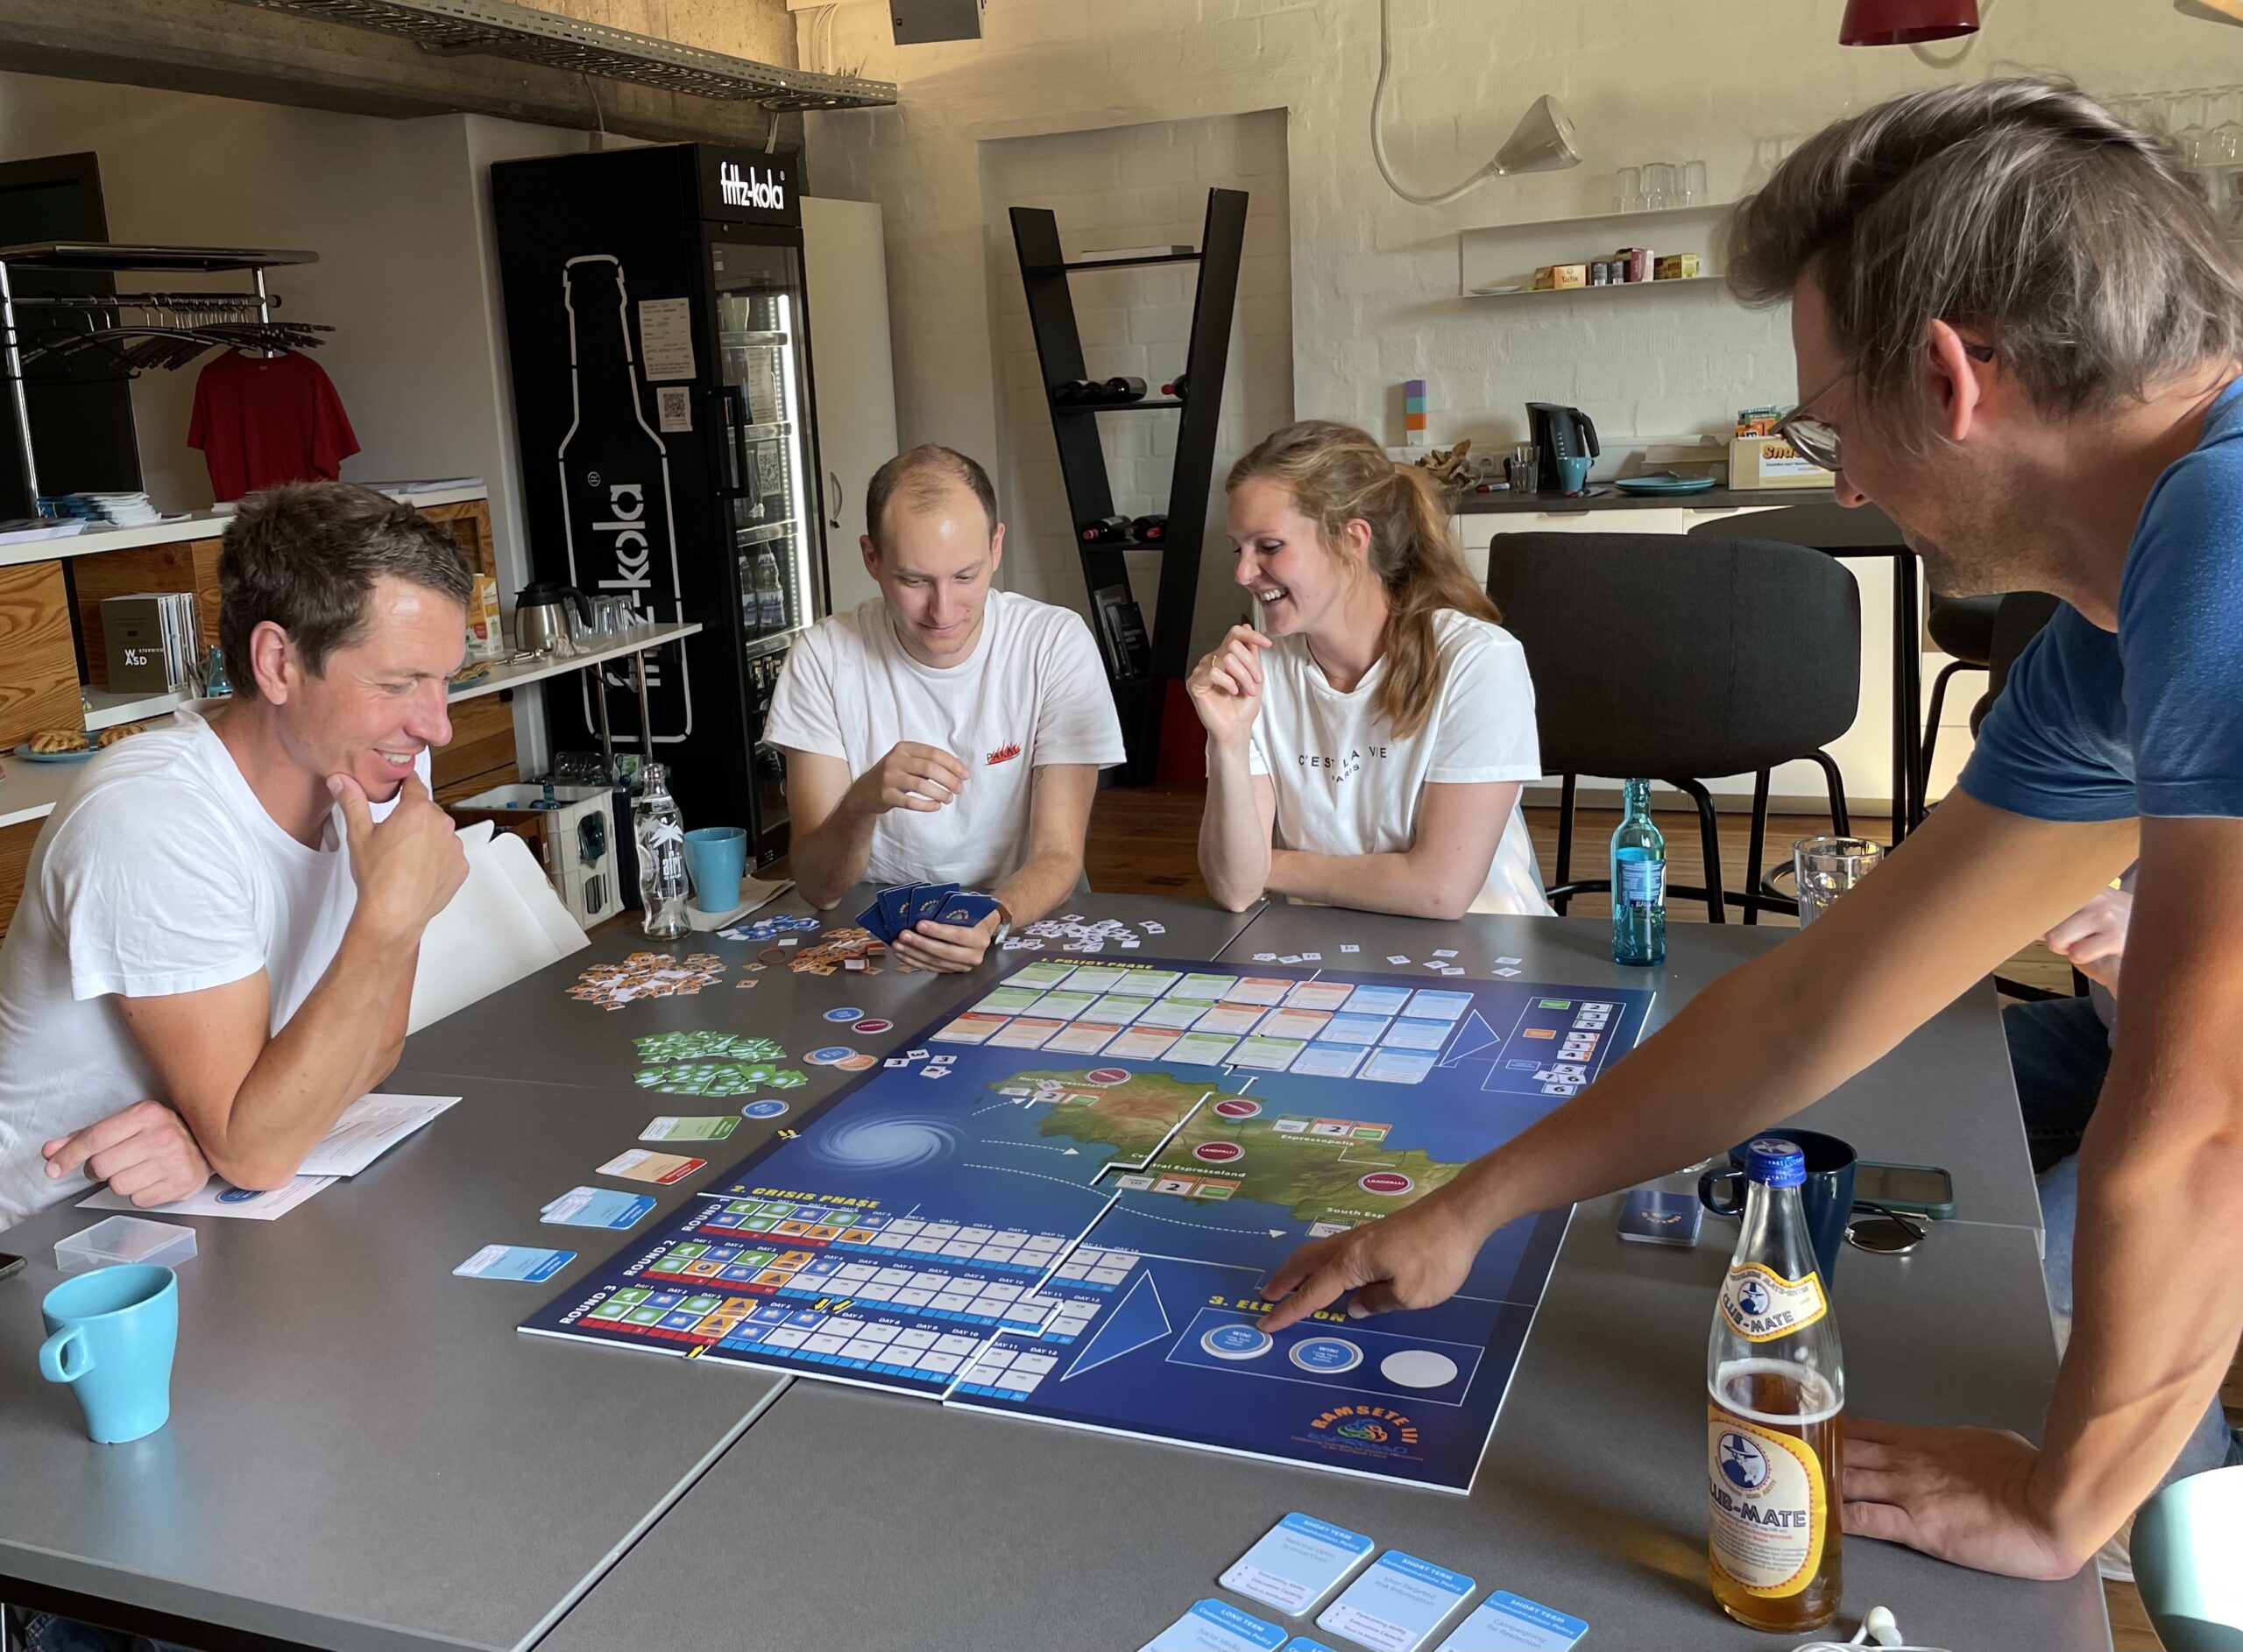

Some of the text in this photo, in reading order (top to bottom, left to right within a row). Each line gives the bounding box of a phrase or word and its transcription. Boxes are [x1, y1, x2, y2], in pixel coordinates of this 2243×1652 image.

[721, 161, 784, 209] fritz-kola
[1343, 749, 1360, 768] LA
[1369, 746, 1387, 759] VIE
[662, 851, 681, 875] afri
[1280, 1133, 1355, 1147] Espressopolis
[1173, 1164, 1247, 1178] Espressoland
[1165, 1183, 1180, 1191] 2
[752, 1188, 817, 1201] CRISIS
[819, 1195, 881, 1209] PHASE
[681, 1204, 722, 1232] ROUND
[1326, 1207, 1362, 1216] South
[623, 1246, 667, 1276] ROUND
[559, 1292, 606, 1324] ROUND
[1209, 1295, 1347, 1323] 3. ELEON
[1311, 1405, 1410, 1430] RAMSETE
[1304, 1520, 1352, 1541] SHORT TERM
[1402, 1558, 1454, 1581] SHORT TERM
[1440, 1579, 1462, 1592] Policy
[1221, 1608, 1264, 1633] LONG TERM
[1510, 1599, 1566, 1623] SHORT TERM
[1251, 1631, 1273, 1645] Policy
[1551, 1622, 1575, 1635] Policy
